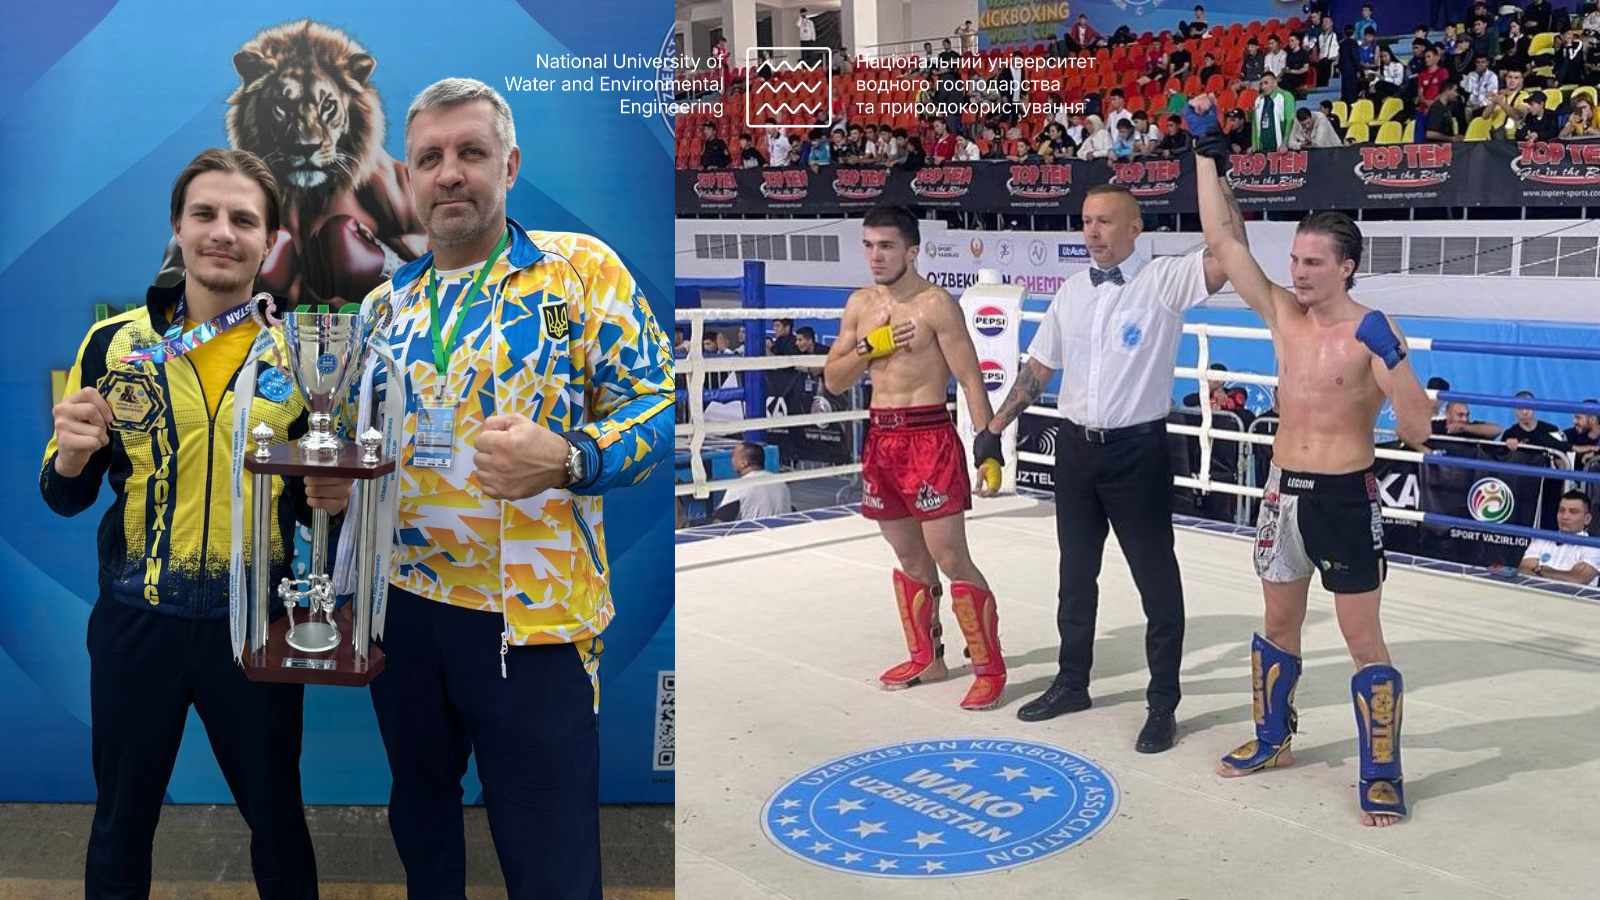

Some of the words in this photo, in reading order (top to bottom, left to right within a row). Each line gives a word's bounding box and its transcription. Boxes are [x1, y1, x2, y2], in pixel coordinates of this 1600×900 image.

[1229, 152, 1267, 176] TOP
[1267, 150, 1309, 175] TEN
[1360, 145, 1403, 170] TOP
[1403, 143, 1453, 168] TEN
[1517, 141, 1566, 165] TOP
[836, 169, 860, 186] TOP
[916, 167, 943, 186] TOP
[943, 166, 973, 184] TEN
[1010, 164, 1039, 185] TOP
[1041, 164, 1073, 184] TEN
[1113, 163, 1147, 184] TOP
[1148, 160, 1181, 182] TEN
[1387, 171, 1397, 179] in
[1400, 171, 1415, 179] the
[1546, 167, 1558, 176] in
[1562, 167, 1580, 176] the
[975, 317, 1006, 327] PEPSI
[983, 371, 1005, 381] EPSI
[1287, 477, 1316, 490] LEGION
[1451, 529, 1481, 542] SPORT
[1482, 532, 1528, 547] VAZIRLIGI
[1371, 680, 1394, 726] TOP
[1371, 727, 1394, 764] TEN
[800, 741, 957, 787] UZBEKISTAN
[970, 740, 1100, 784] KICKBOXING
[901, 768, 1025, 818] WAKO
[849, 775, 1015, 844] UZBEKISTAN
[985, 785, 1107, 866] ASSOCIATION
